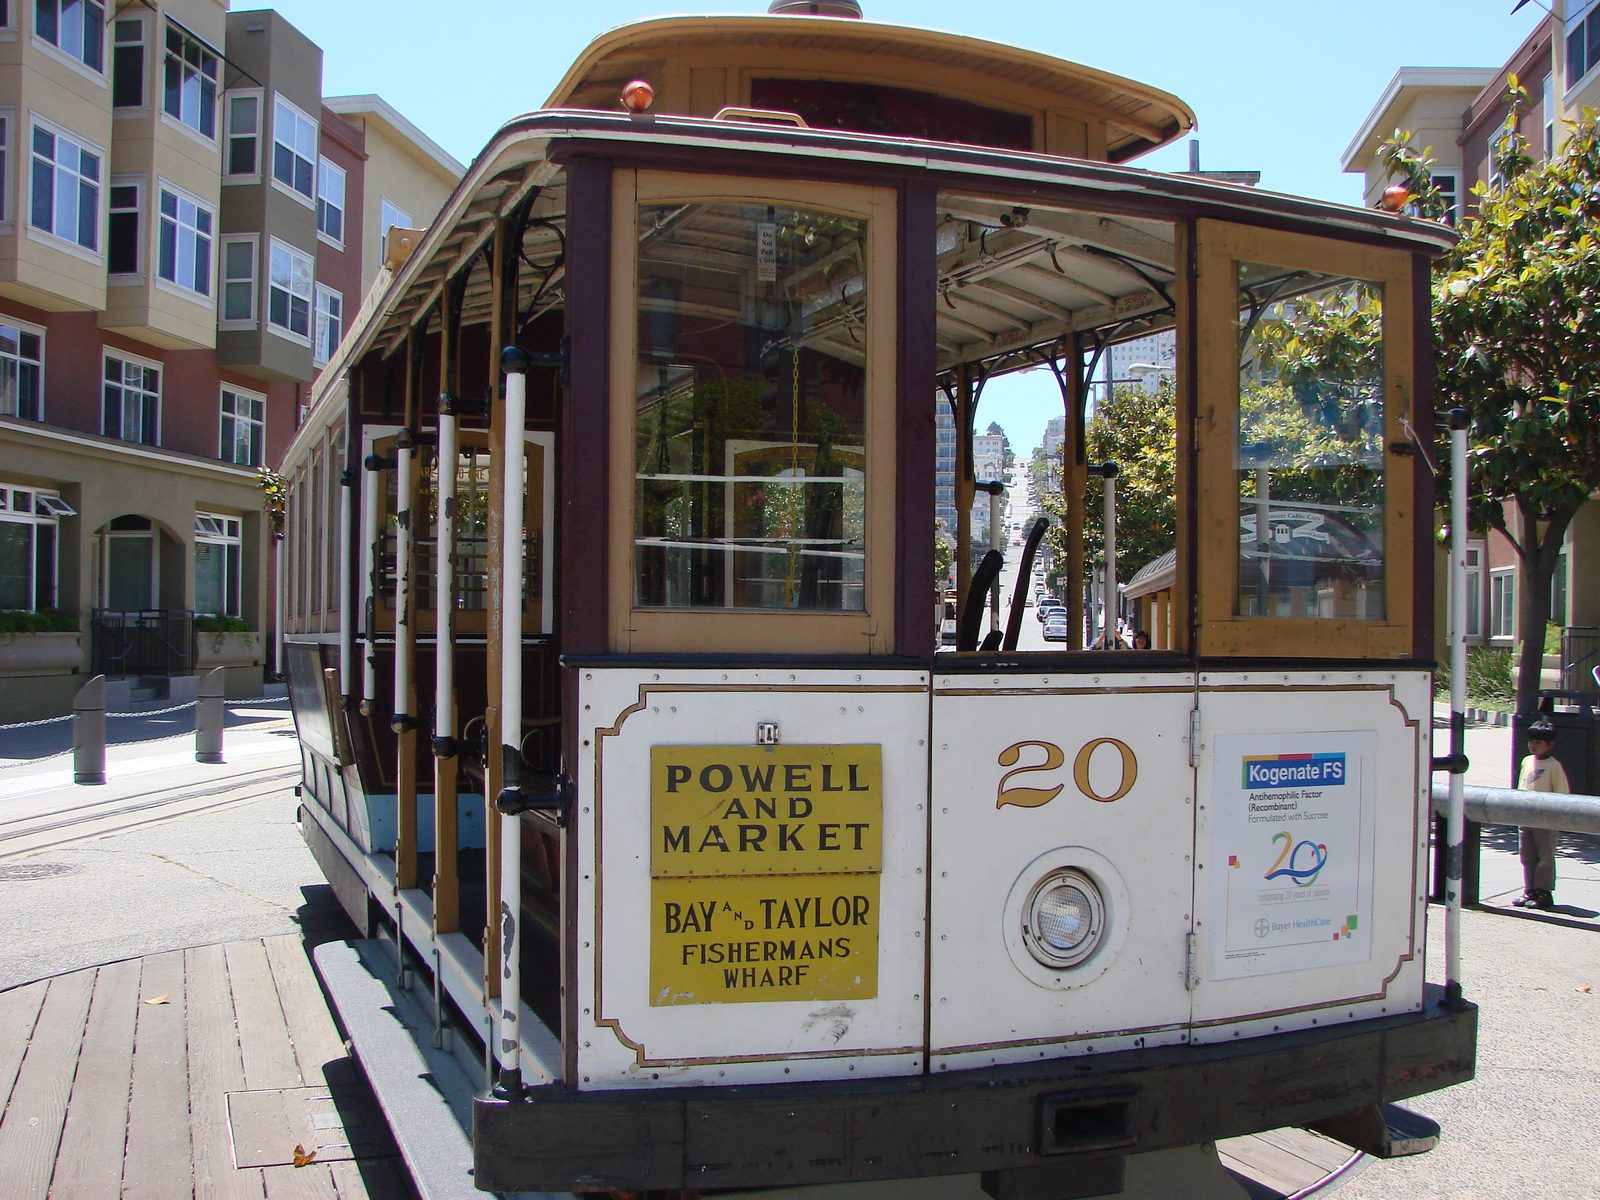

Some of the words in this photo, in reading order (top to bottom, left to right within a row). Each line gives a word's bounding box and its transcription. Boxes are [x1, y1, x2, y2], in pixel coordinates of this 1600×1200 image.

[665, 763, 870, 793] POWELL
[996, 737, 1138, 810] 20
[1249, 764, 1320, 786] Kogenate
[1322, 761, 1343, 779] FS
[1248, 801, 1297, 812] (Recombinant)
[1249, 791, 1299, 801] Antihemophilic
[1301, 789, 1323, 799] Factor
[721, 797, 813, 820] AND
[1247, 814, 1286, 823] Formulated
[1287, 813, 1302, 822] with
[1303, 812, 1328, 821] Sucrose
[663, 823, 870, 853] MARKET
[664, 901, 717, 934] BAY
[759, 895, 870, 930] TAYLOR
[1272, 922, 1291, 931] Bayer
[1293, 918, 1331, 929] HealthCare
[682, 937, 851, 966] FISHERMANS
[723, 965, 810, 989] WHARF
